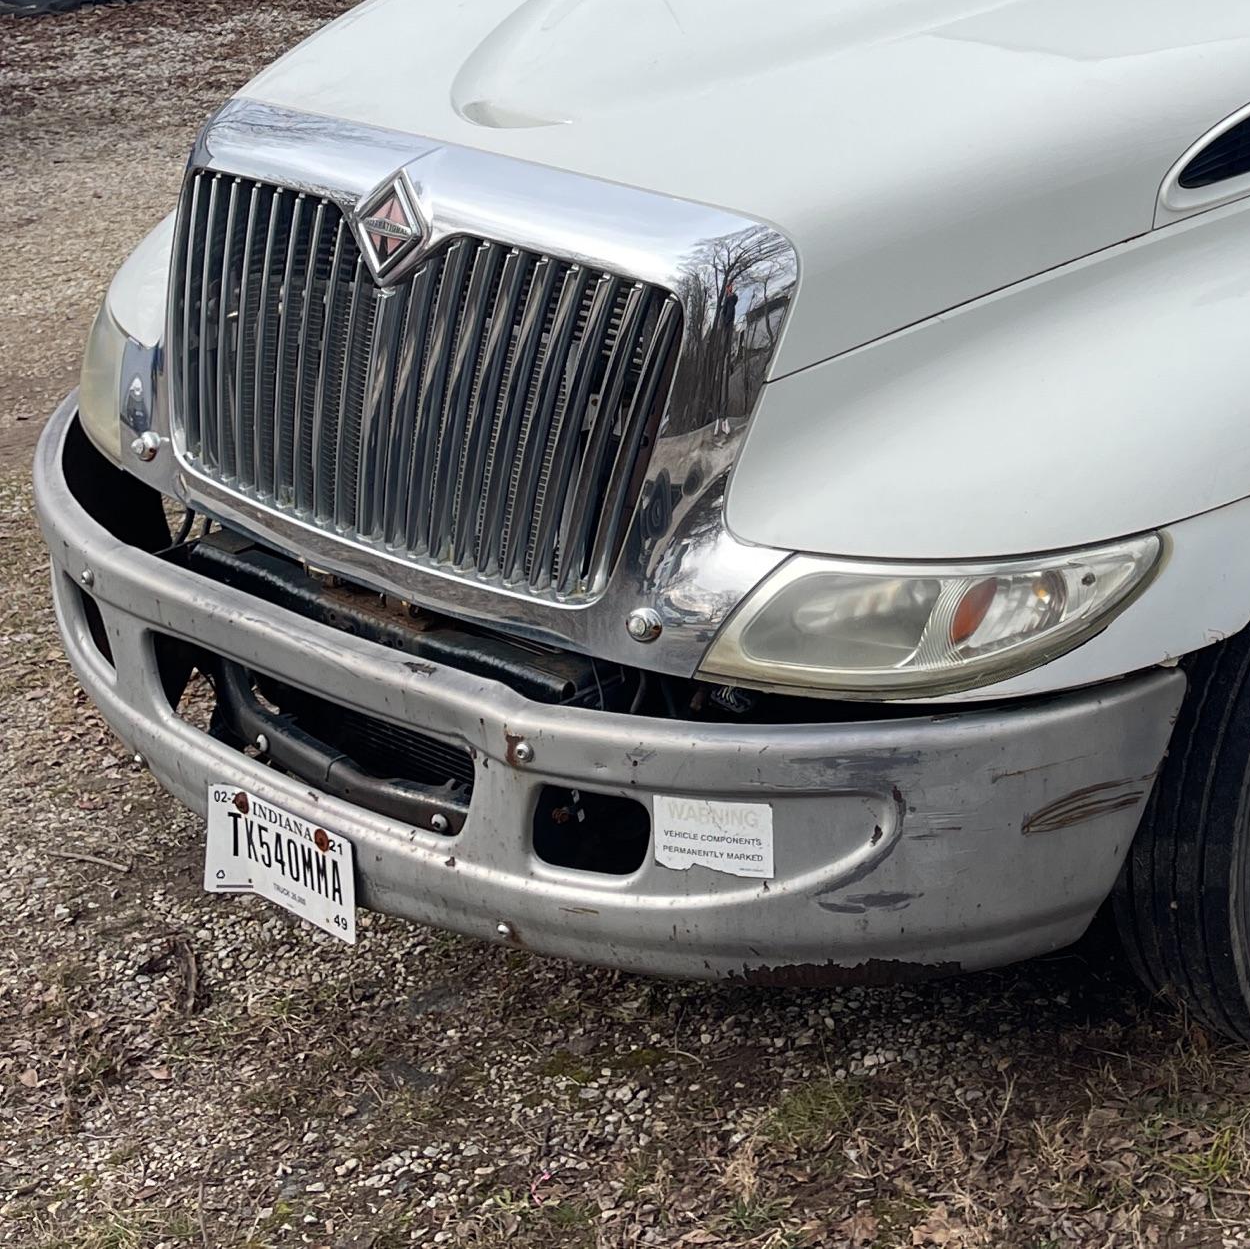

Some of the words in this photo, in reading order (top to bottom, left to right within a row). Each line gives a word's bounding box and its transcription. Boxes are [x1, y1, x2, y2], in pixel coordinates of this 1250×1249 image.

[252, 801, 313, 842] INDIANA
[667, 802, 759, 828] WARNING
[664, 830, 698, 841] VEHICLE
[700, 835, 762, 847] COMPONENTS
[662, 845, 725, 859] PERMANENTLY
[726, 851, 763, 862] MARKED
[334, 914, 348, 931] 49
